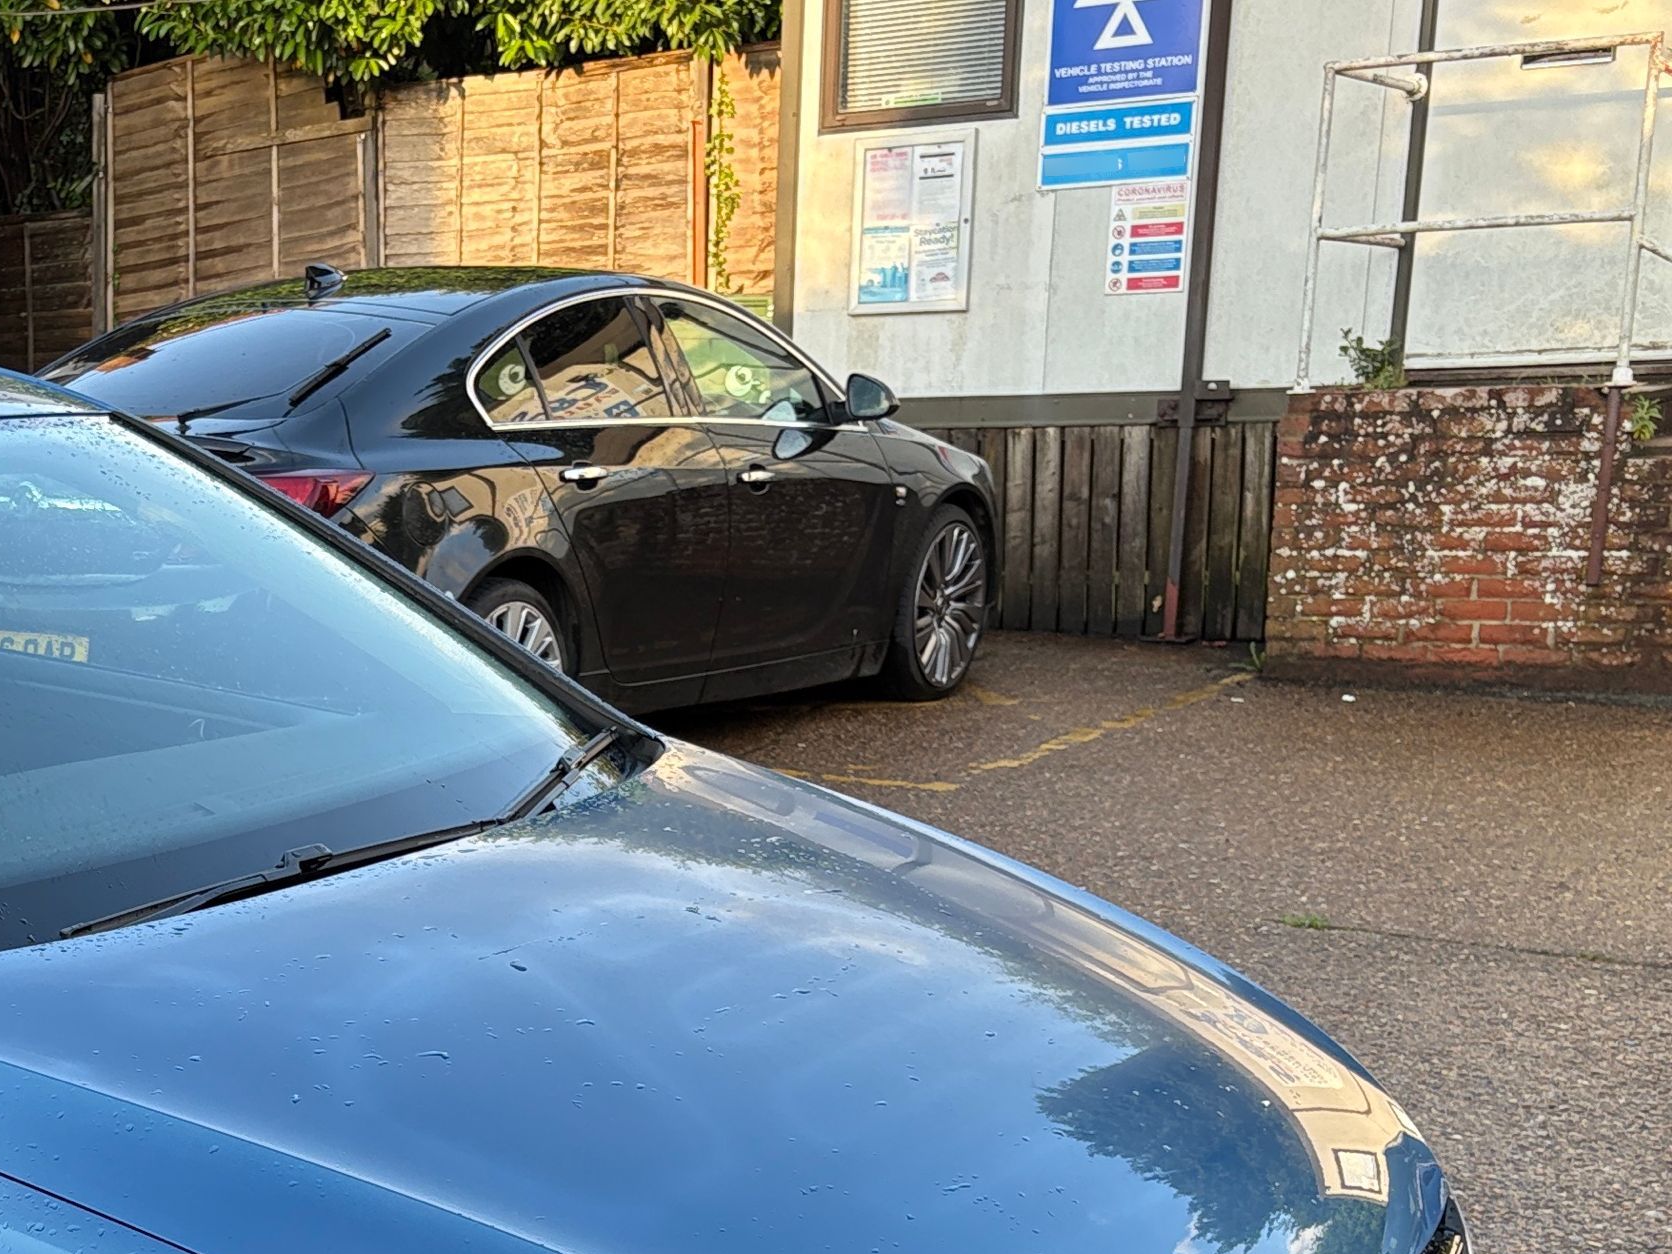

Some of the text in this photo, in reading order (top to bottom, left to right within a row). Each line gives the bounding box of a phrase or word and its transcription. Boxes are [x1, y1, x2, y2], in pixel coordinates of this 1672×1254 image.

[1054, 54, 1193, 79] VEHICLE TESTING STATION
[1078, 77, 1163, 93] VEHICLE INSPECTORATE
[1087, 70, 1154, 84] APPROVED BY THE
[1055, 113, 1182, 136] DIESELS TESTED
[1117, 183, 1185, 197] CORONAVIRUS
